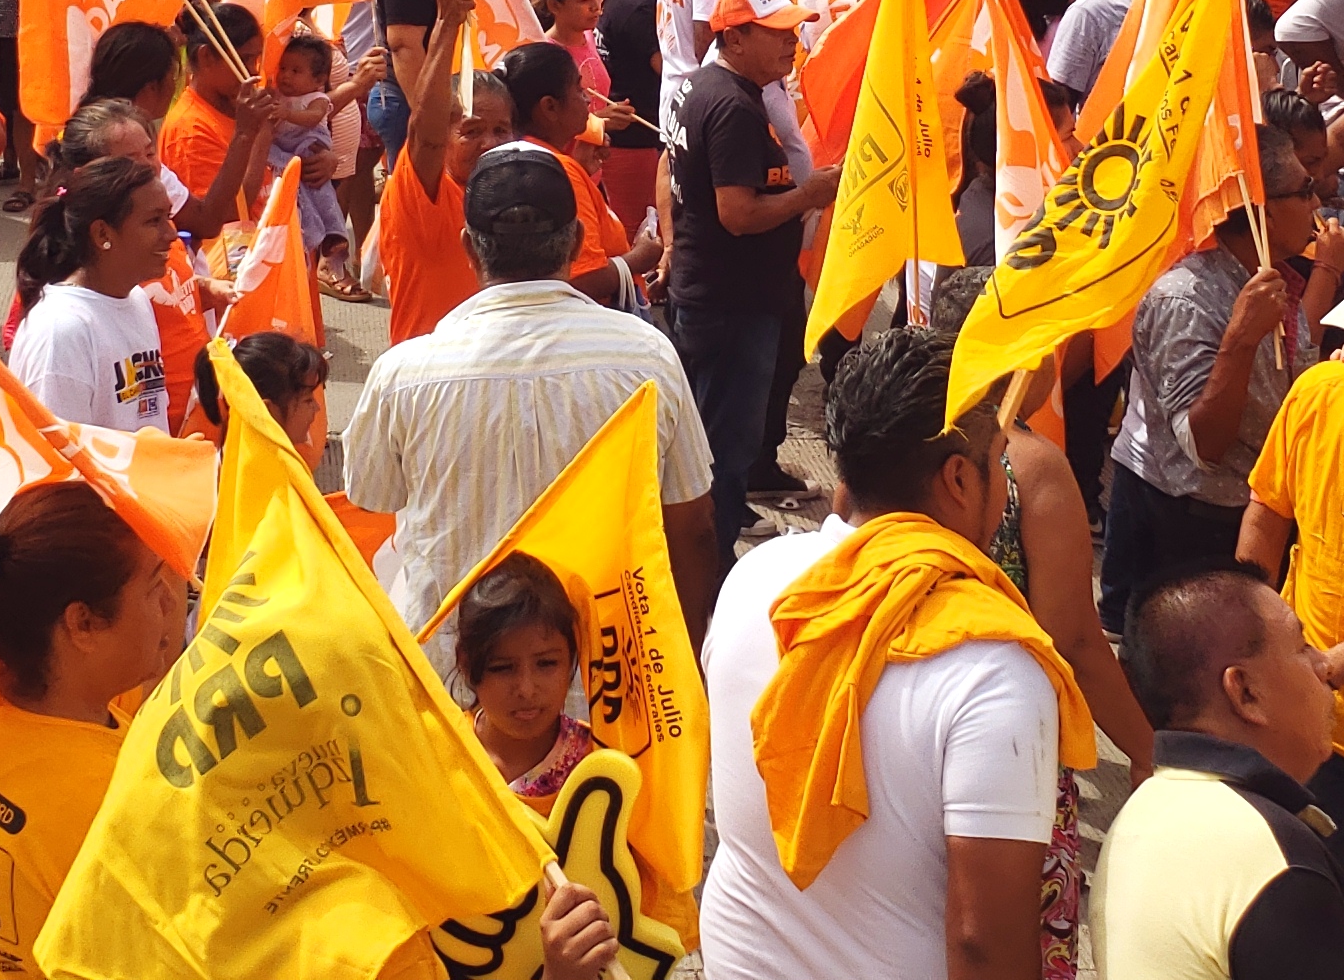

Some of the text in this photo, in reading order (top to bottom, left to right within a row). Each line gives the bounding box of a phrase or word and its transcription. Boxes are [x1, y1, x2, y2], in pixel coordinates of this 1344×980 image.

[624, 569, 665, 743] Candidatos Federales
[632, 566, 683, 738] Vota 1 de Julio
